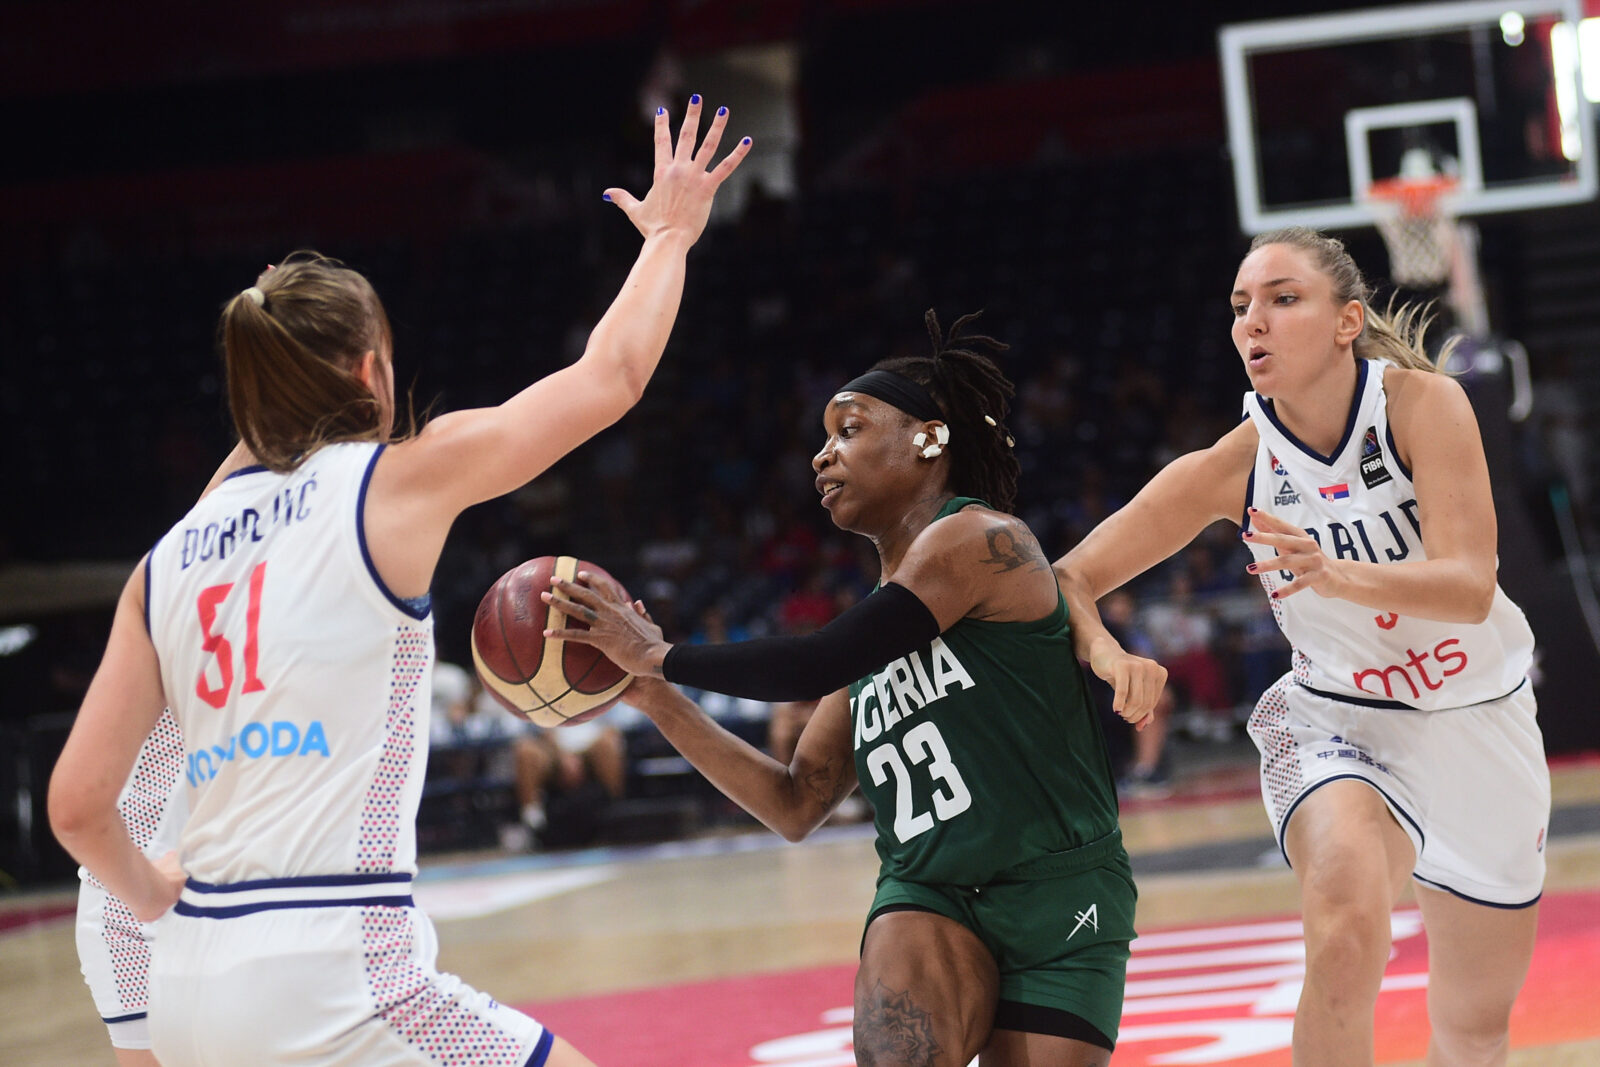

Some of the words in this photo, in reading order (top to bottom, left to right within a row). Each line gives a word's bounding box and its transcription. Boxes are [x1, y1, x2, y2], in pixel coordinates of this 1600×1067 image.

[1274, 493, 1301, 506] PEAK
[1362, 458, 1384, 475] FIBA
[196, 560, 268, 709] 51
[1352, 638, 1468, 700] mts
[850, 636, 976, 751] IGERIA
[866, 721, 972, 844] 23
